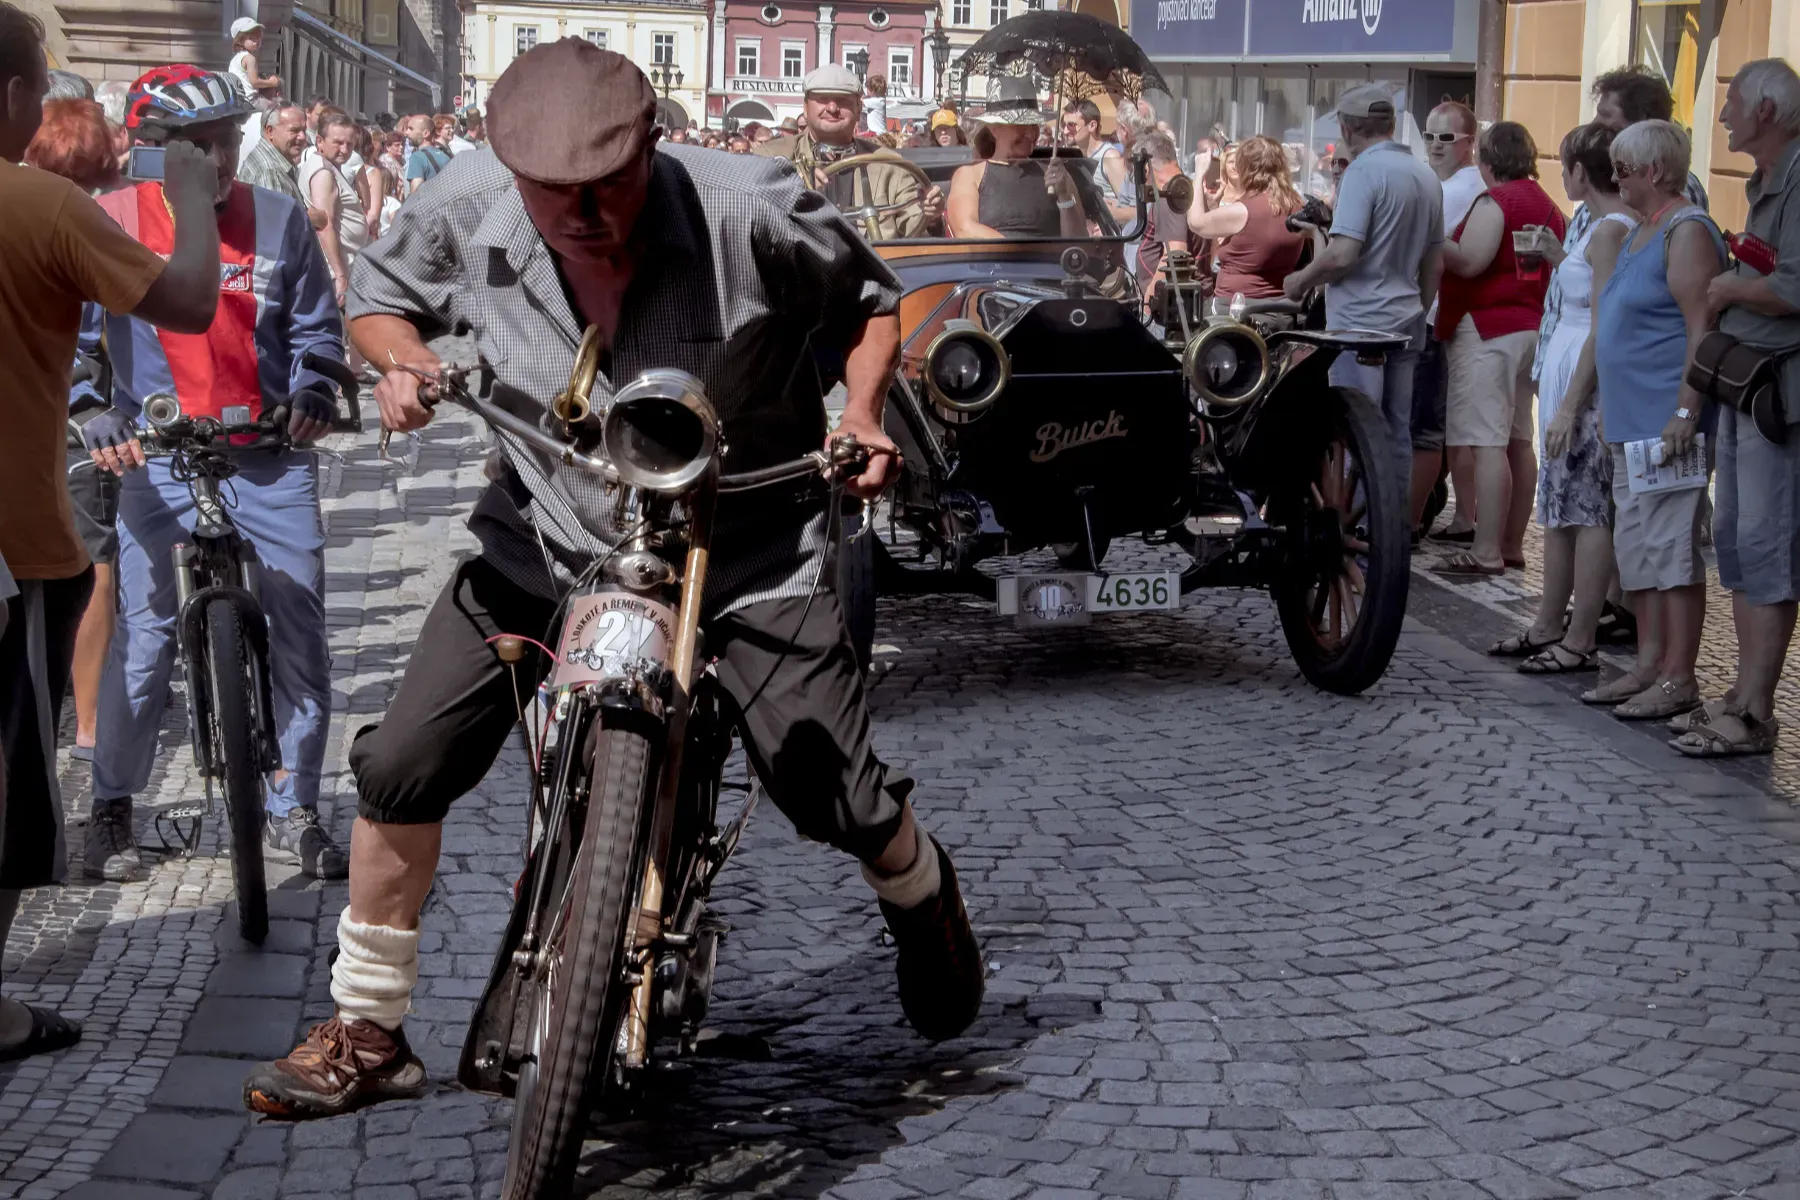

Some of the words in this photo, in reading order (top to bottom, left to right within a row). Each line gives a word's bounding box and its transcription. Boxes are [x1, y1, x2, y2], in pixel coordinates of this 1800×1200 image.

[1029, 409, 1129, 463] Buick
[1038, 585, 1061, 610] 10
[1096, 575, 1169, 606] 4636
[602, 601, 608, 611] A
[650, 609, 658, 619] V
[596, 610, 656, 658] 27
